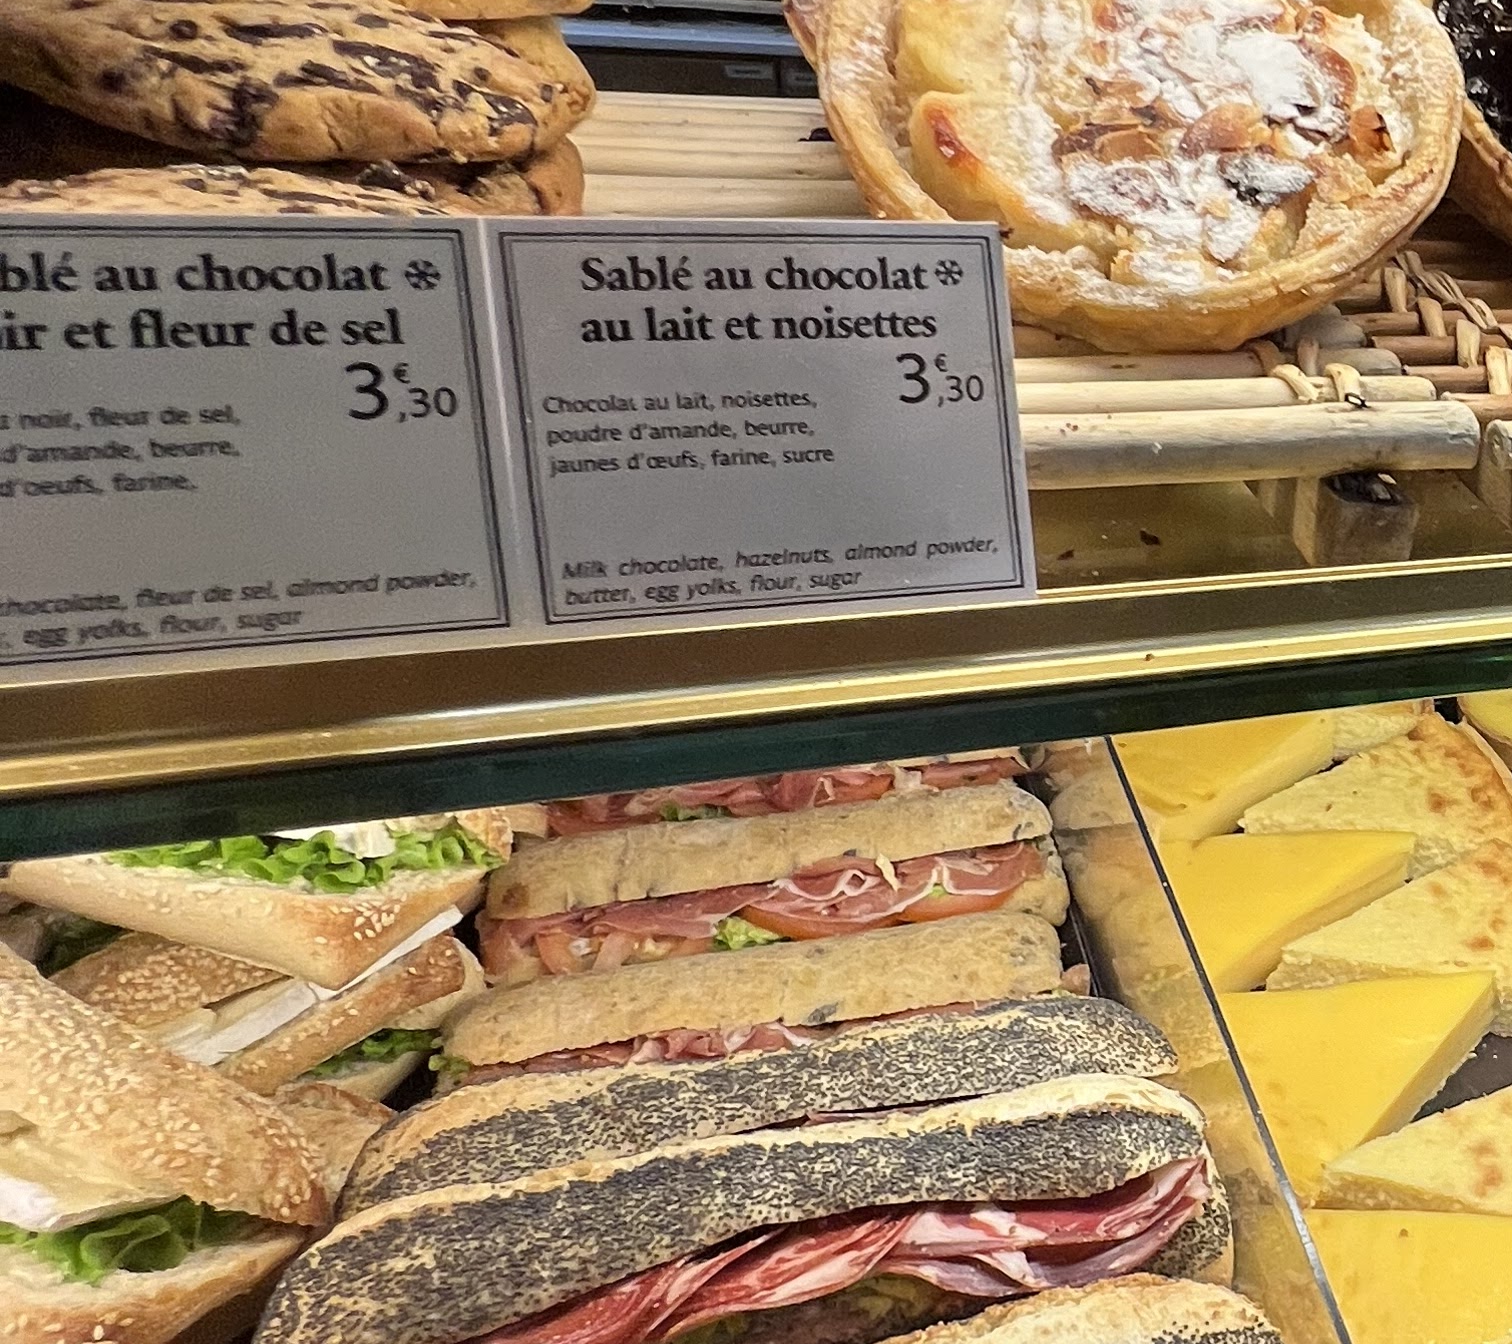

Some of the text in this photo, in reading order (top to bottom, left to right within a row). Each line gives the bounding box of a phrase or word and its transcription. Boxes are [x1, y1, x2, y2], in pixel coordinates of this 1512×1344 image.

[95, 264, 158, 292] au
[176, 253, 389, 292] chocolat
[581, 257, 929, 292] Sablé au chocolat
[0, 309, 403, 351] ir et fleur de sel
[581, 307, 937, 342] au lait et noisettes
[542, 392, 817, 414] Chocolat au lait, noisettes,
[546, 423, 622, 447] poudre
[744, 419, 816, 437] beurre,
[550, 456, 620, 478] jaunes
[710, 449, 777, 468] farine,
[782, 448, 835, 464] sucre
[562, 538, 998, 579] Milk chocolate, hazelnuts, almond powder,
[564, 571, 862, 606] butter, egg yolks, flour, sugar
[237, 611, 302, 631] sugar
